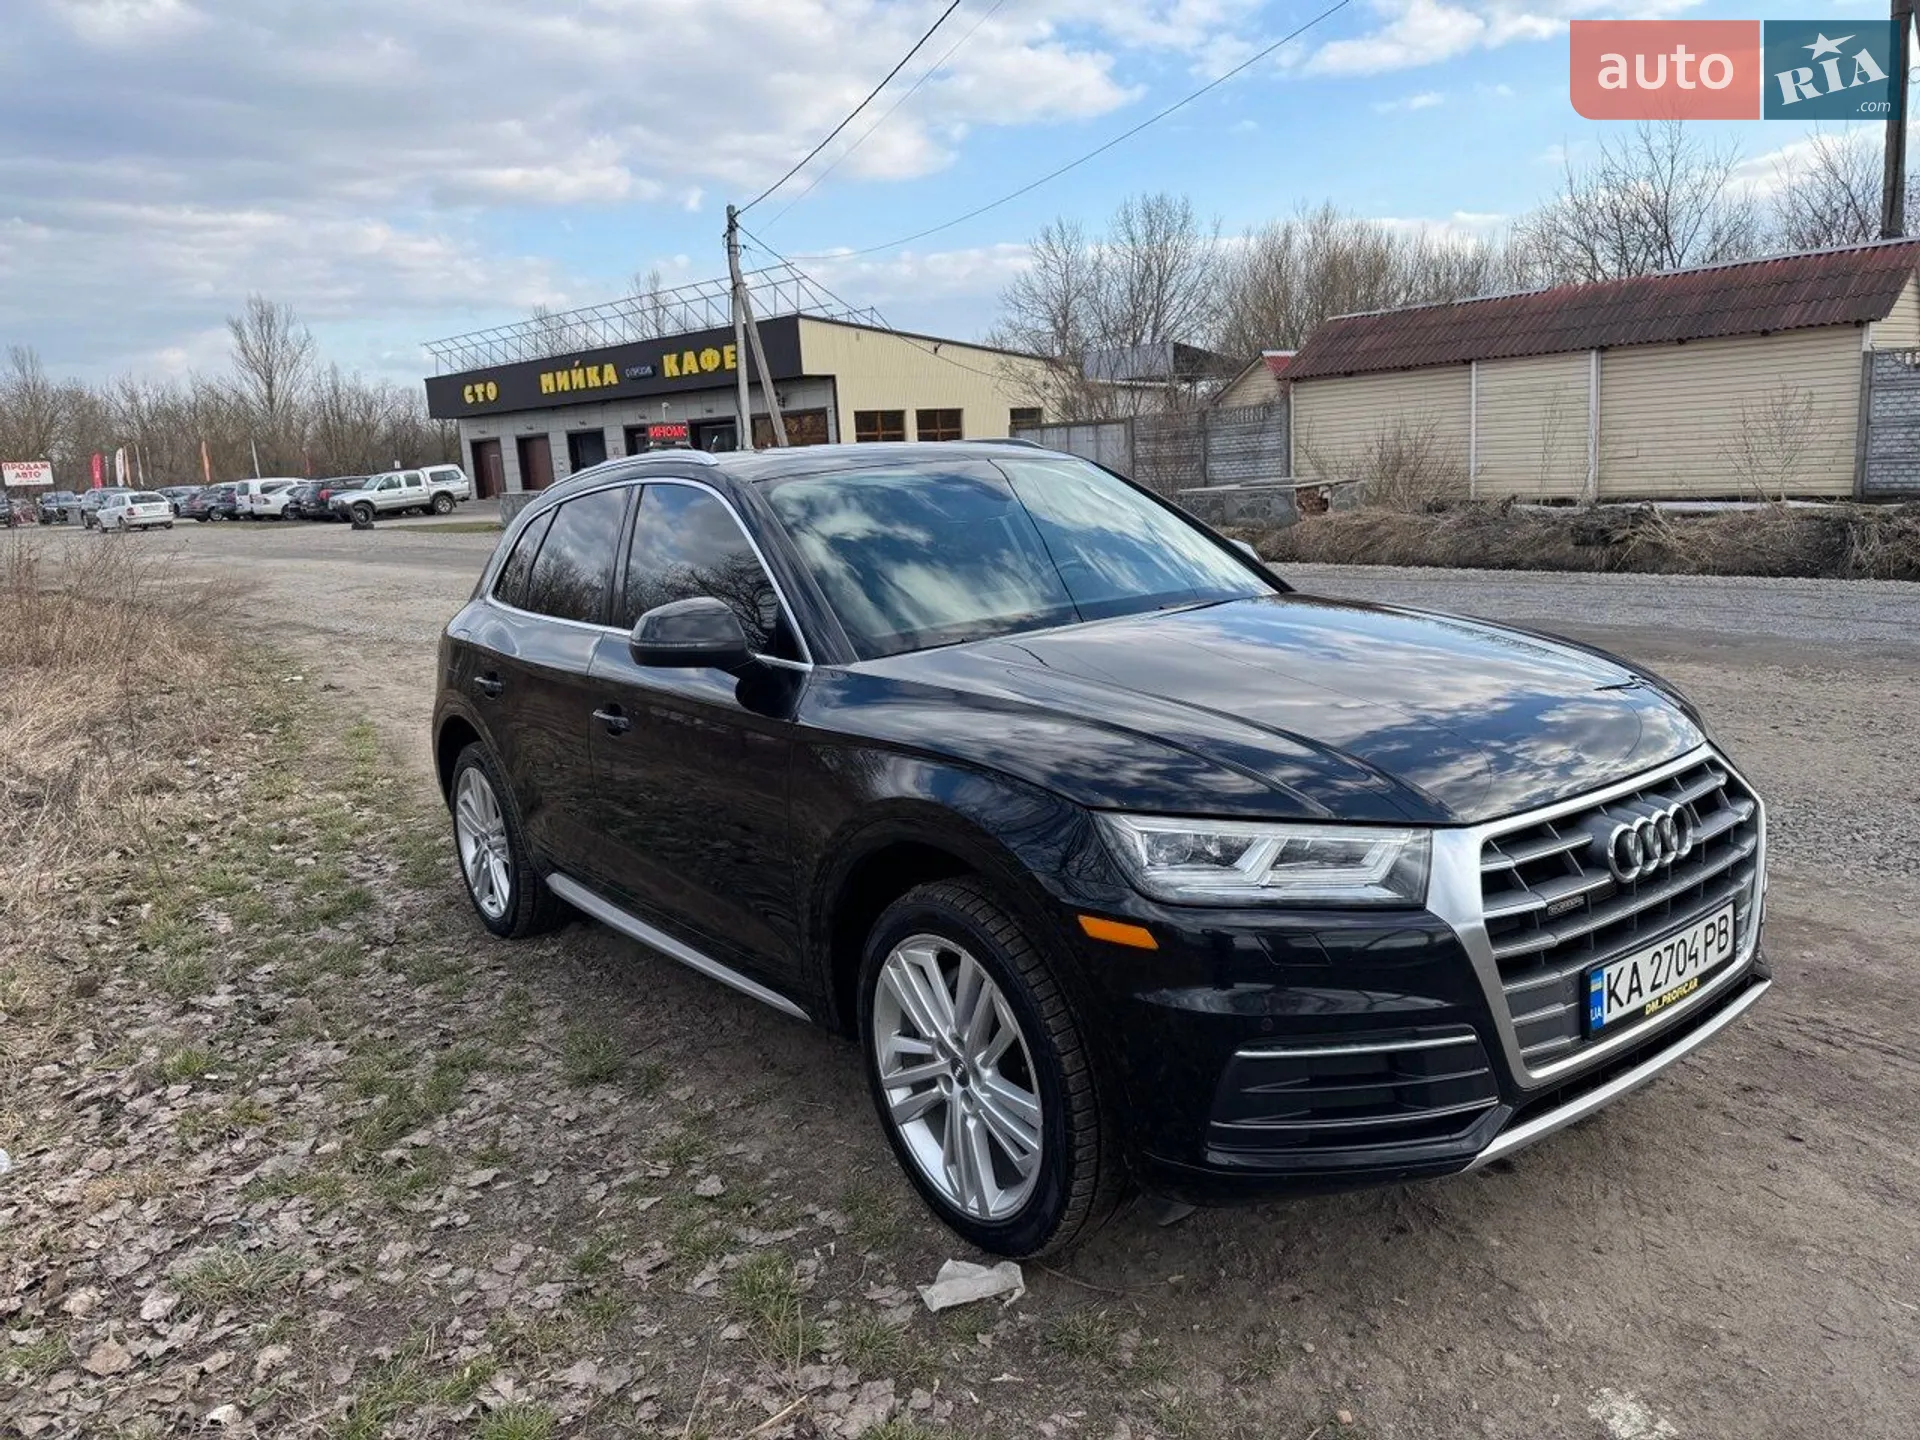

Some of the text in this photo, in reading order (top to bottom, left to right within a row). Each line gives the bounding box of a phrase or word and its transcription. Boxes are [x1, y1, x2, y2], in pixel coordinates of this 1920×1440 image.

[464, 381, 498, 404] СТО
[540, 360, 619, 394] МИЙКА
[663, 344, 737, 378] КАФЕ
[15, 471, 42, 479] АВТО
[1606, 913, 1730, 1014] KA 2704 PB
[1590, 1006, 1604, 1021] UA
